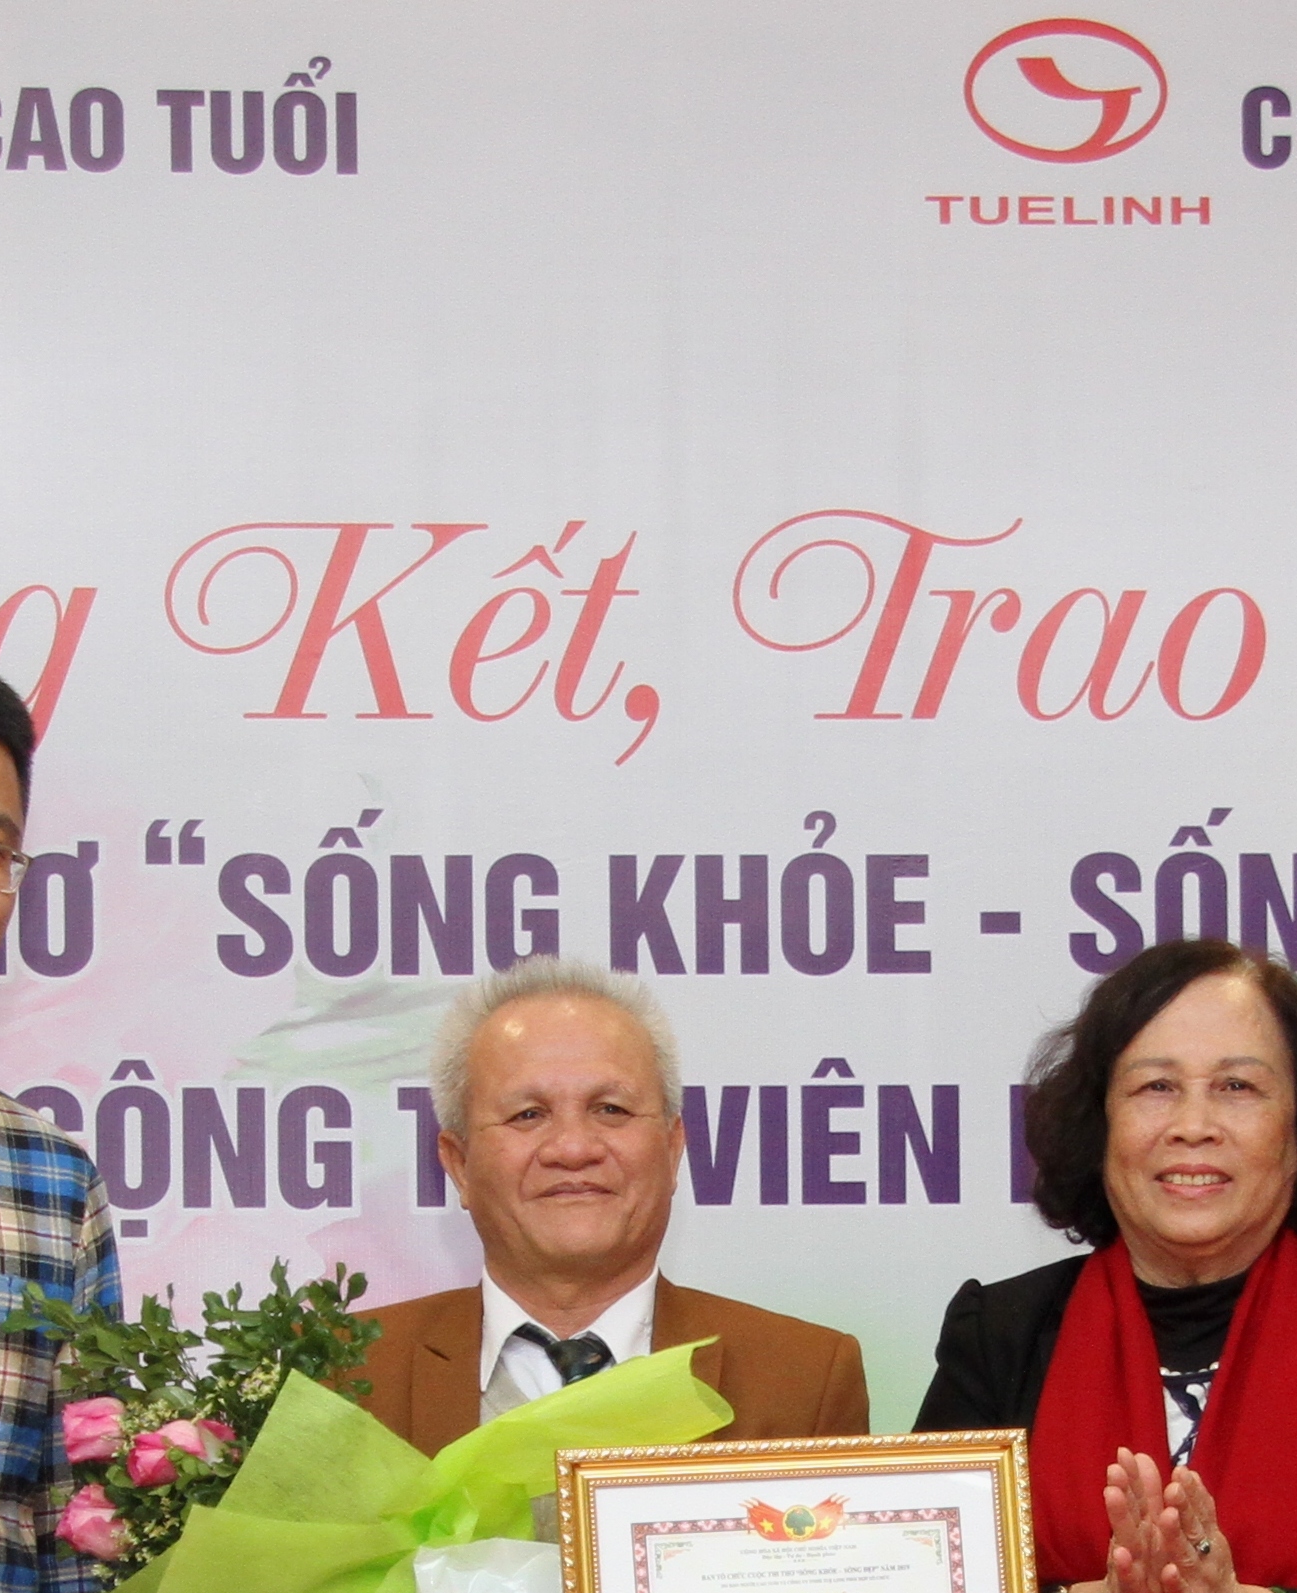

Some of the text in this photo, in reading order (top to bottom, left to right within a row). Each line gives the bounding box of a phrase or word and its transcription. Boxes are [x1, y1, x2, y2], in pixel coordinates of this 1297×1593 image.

[157, 57, 358, 174] TUỔI
[925, 195, 1212, 226] TUELINH
[164, 519, 661, 767] Kết,
[732, 508, 1268, 722] Trao
[609, 810, 933, 976] KHỎE
[980, 911, 1022, 935] -
[680, 1057, 961, 1206] VIÊN
